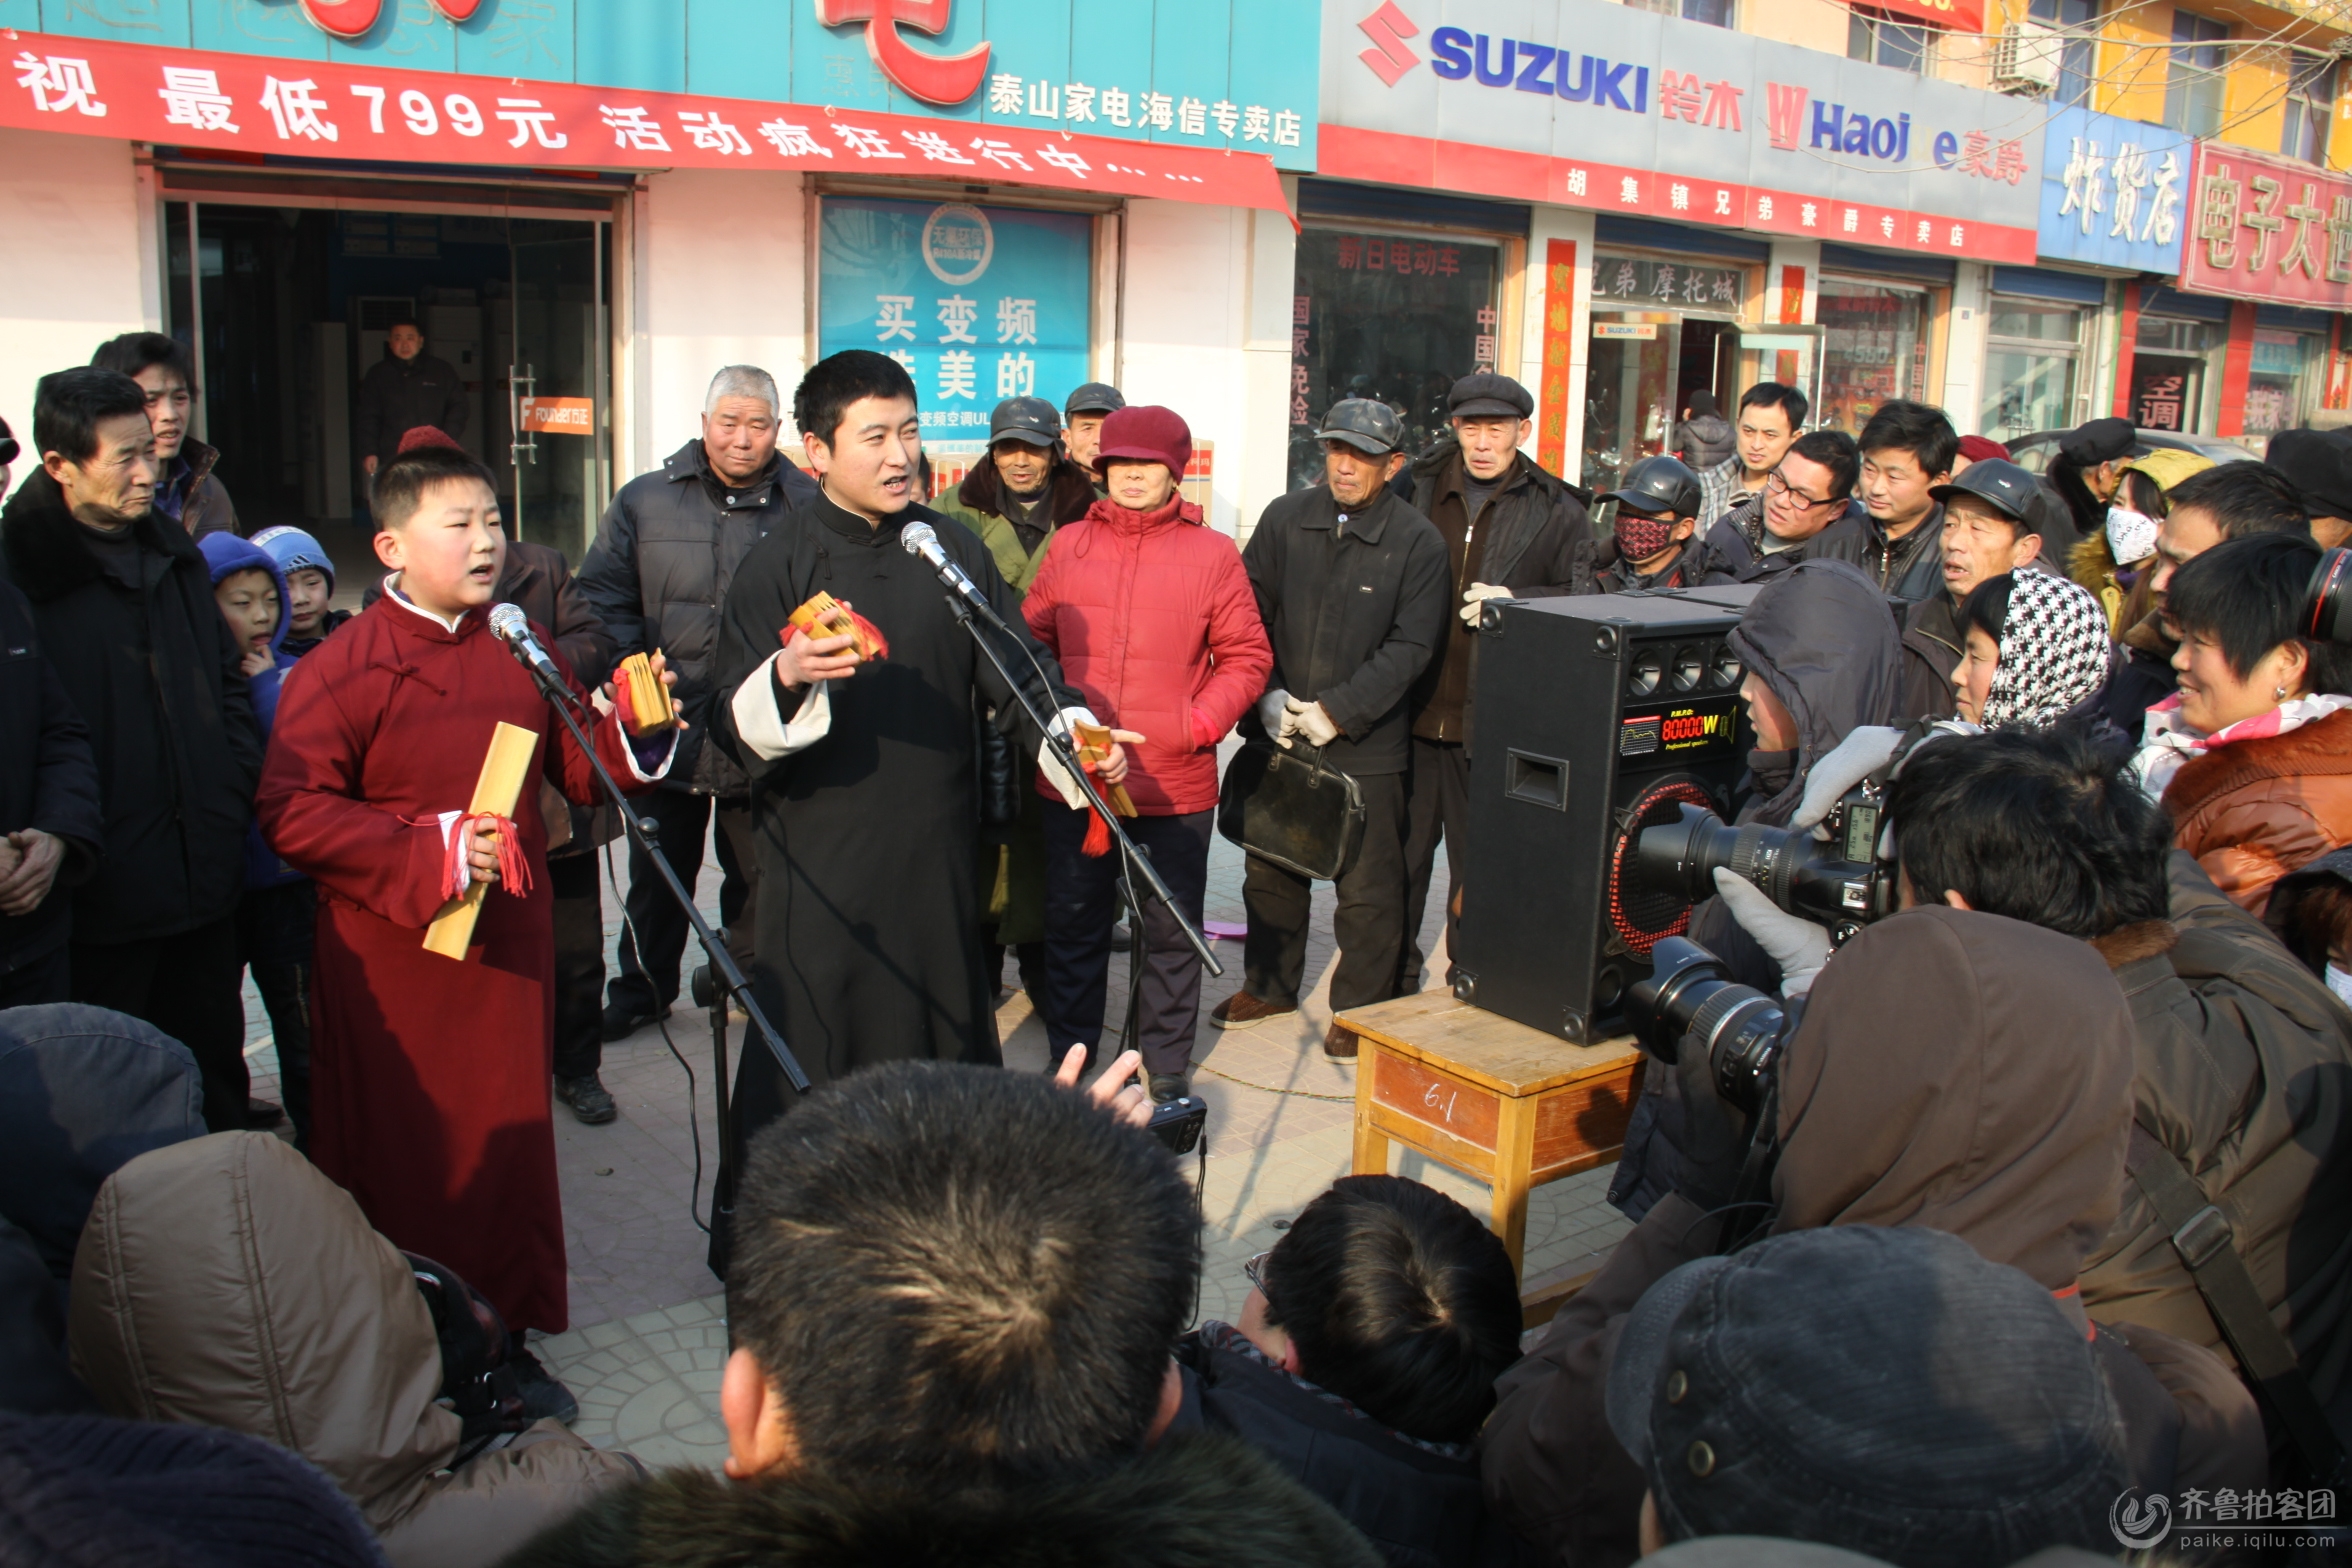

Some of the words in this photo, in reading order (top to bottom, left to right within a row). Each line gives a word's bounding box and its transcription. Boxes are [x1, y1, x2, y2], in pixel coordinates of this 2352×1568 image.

[1431, 26, 1649, 114] SUZUKI
[1658, 69, 1744, 131] 铃木
[990, 73, 1301, 147] 泰山家电海信专卖店
[1958, 129, 2029, 186] 豪爵
[1567, 168, 1964, 247] 胡集镇兄弟豪爵专卖店
[2058, 136, 2181, 246] 炸货店
[1337, 235, 1461, 278] 新日电动车
[875, 294, 1037, 345] 买变频
[2139, 374, 2184, 430] 空调
[1662, 715, 1719, 741] 80000W
